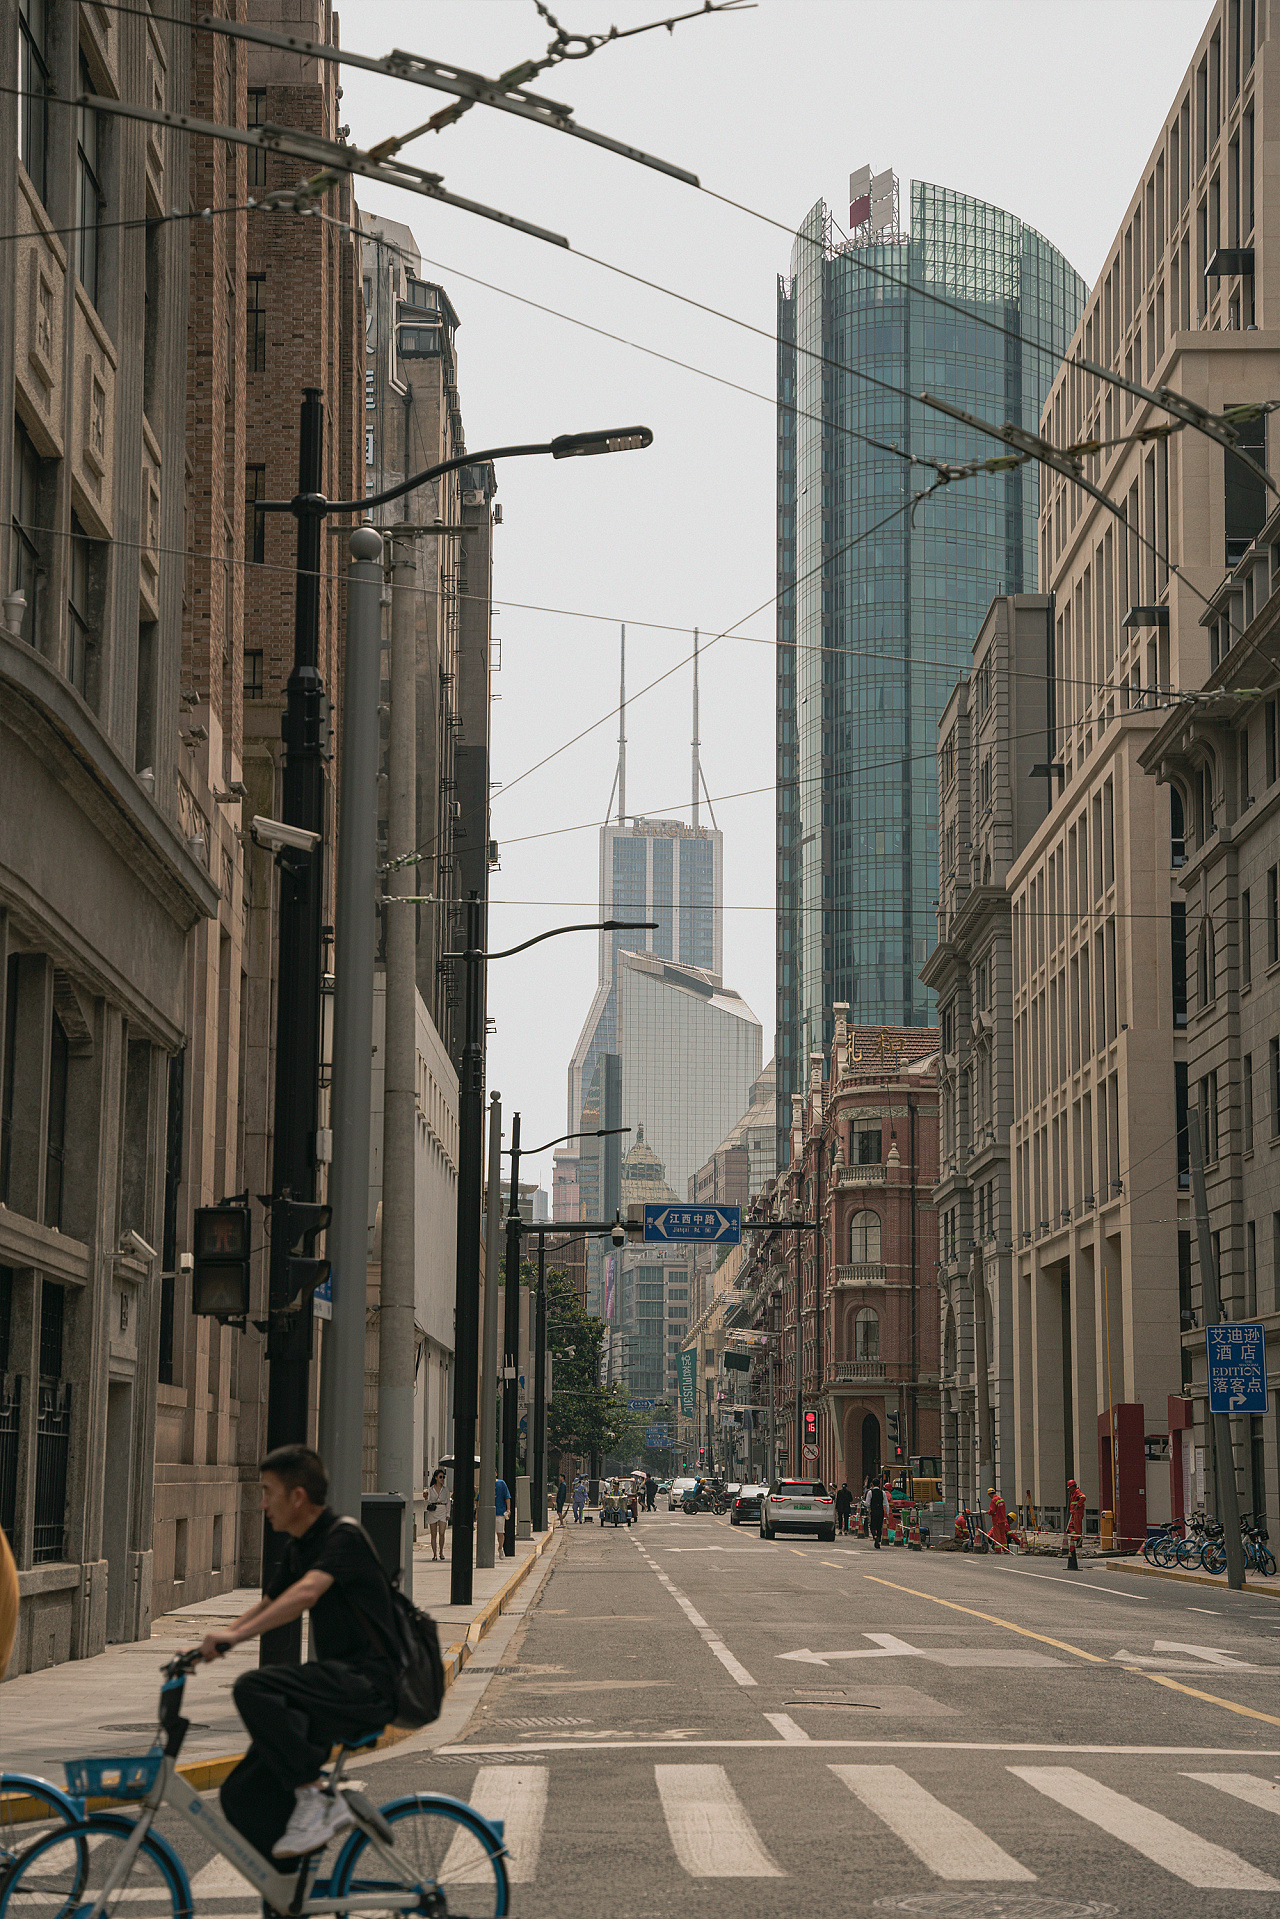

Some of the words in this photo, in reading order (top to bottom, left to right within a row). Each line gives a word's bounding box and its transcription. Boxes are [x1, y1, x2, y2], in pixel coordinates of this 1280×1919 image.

[669, 1213, 715, 1224] 江西中路
[1210, 1328, 1260, 1344] 艾迪逊
[1216, 1344, 1256, 1361] 酒店
[1212, 1367, 1261, 1376] EDITION
[1213, 1377, 1263, 1393] 落客点
[808, 1423, 816, 1432] 16
